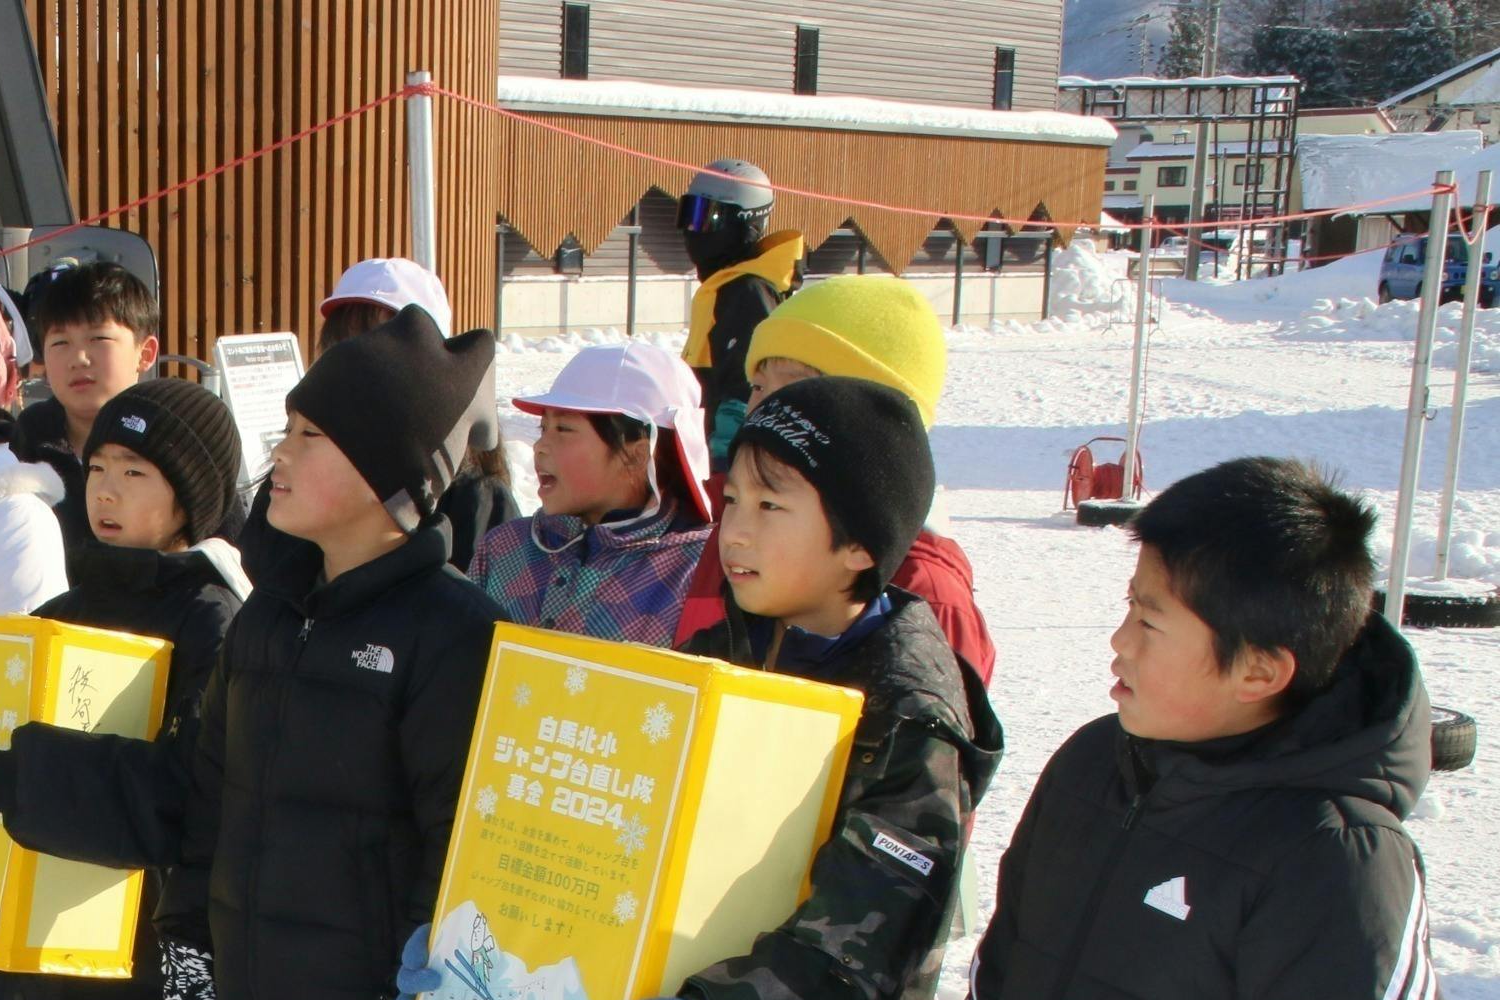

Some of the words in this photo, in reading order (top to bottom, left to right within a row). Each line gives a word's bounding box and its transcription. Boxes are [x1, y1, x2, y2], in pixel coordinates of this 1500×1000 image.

[351, 650, 380, 662] NORTH
[356, 659, 378, 671] FACE
[366, 643, 382, 653] THE
[538, 715, 617, 758] 白馬北小
[493, 735, 655, 804] ジャンプ台直し隊
[507, 773, 544, 807] 募金
[551, 786, 624, 830] 2024
[498, 853, 600, 901] 目標金額100万円
